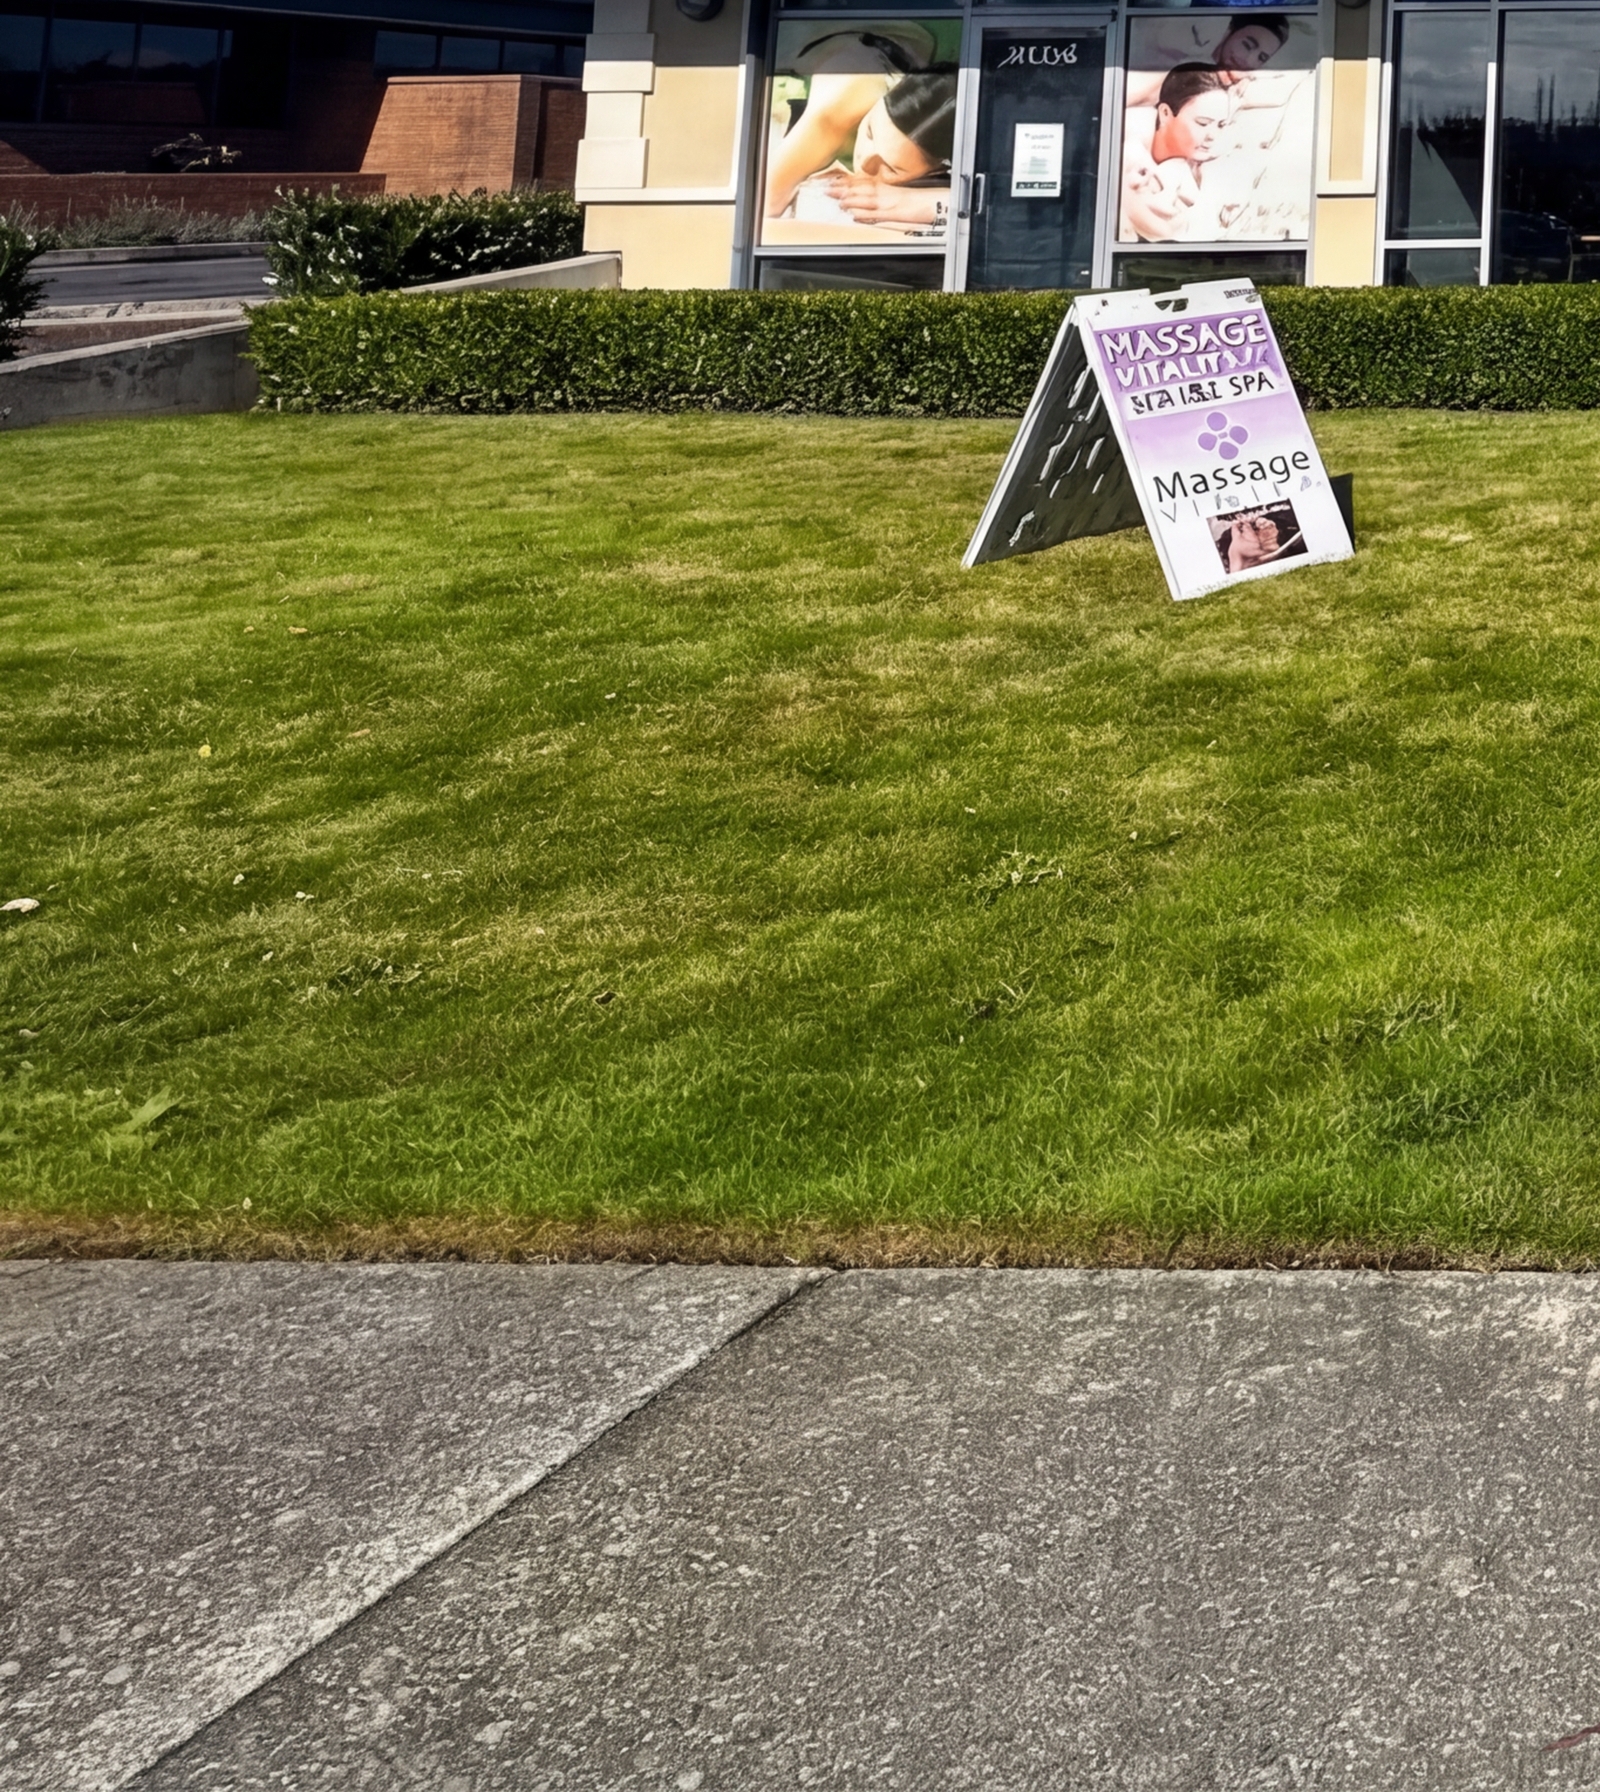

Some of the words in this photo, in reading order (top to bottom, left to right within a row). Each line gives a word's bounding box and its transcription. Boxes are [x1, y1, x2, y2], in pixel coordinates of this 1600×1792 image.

[1100, 313, 1268, 364] MASSAGE
[1229, 371, 1275, 397] SPA
[1152, 450, 1311, 504] Massage
